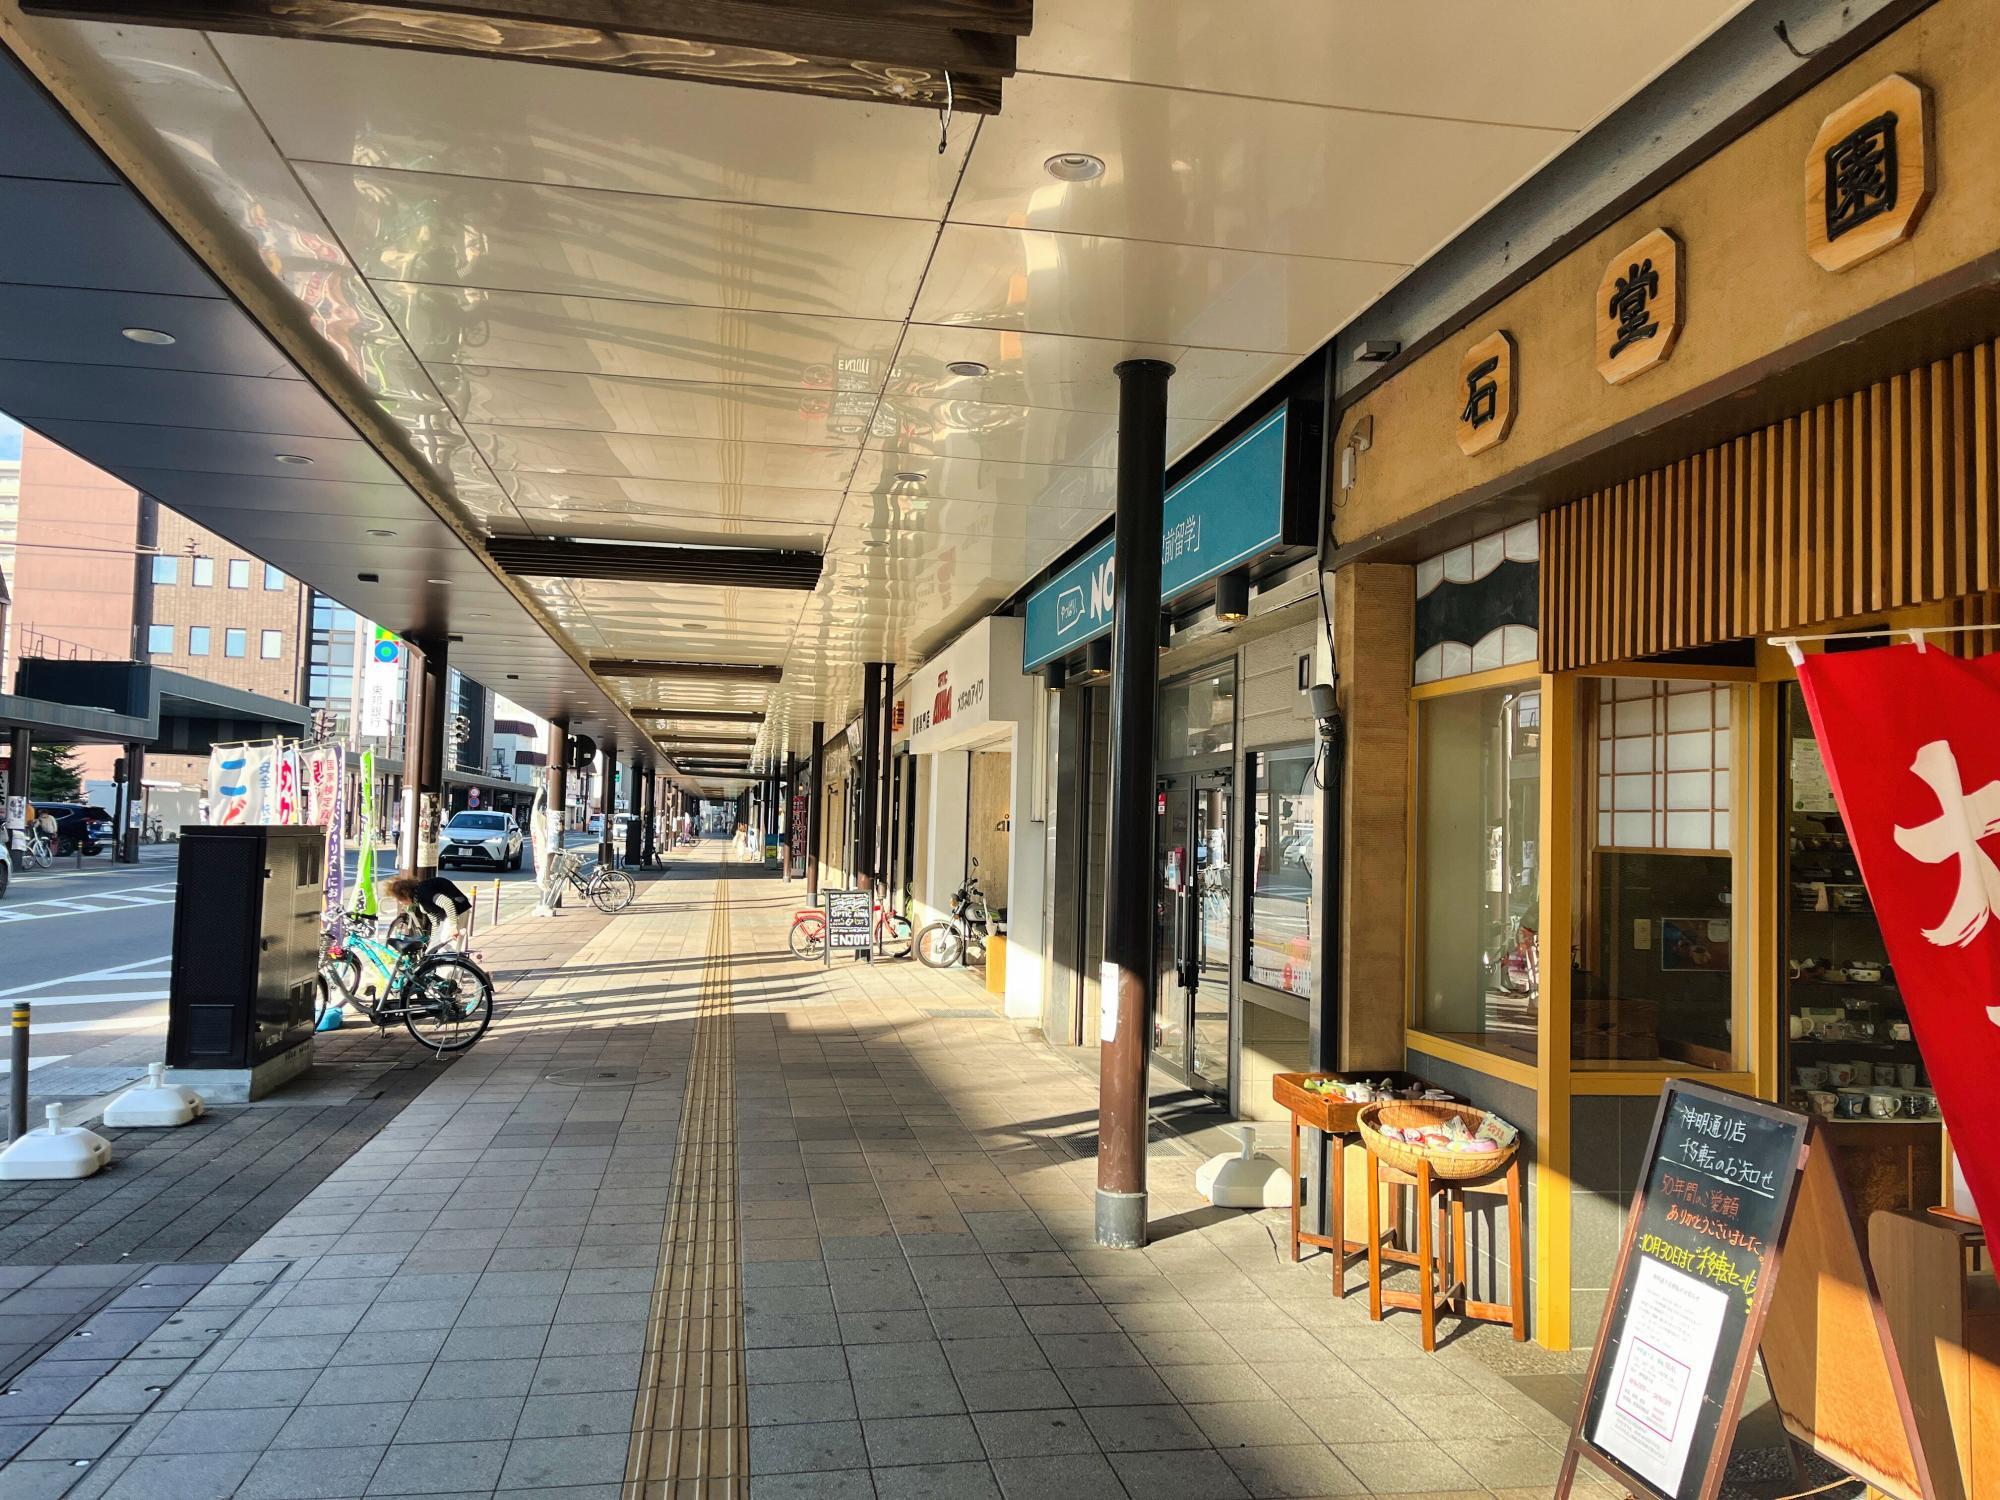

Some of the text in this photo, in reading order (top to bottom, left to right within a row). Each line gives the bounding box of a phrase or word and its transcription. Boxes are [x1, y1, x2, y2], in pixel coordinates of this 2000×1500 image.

[1162, 515, 1201, 564] 前留学」
[831, 934, 870, 946] ENJOY!
[1680, 1105, 1747, 1143] 神明通り店
